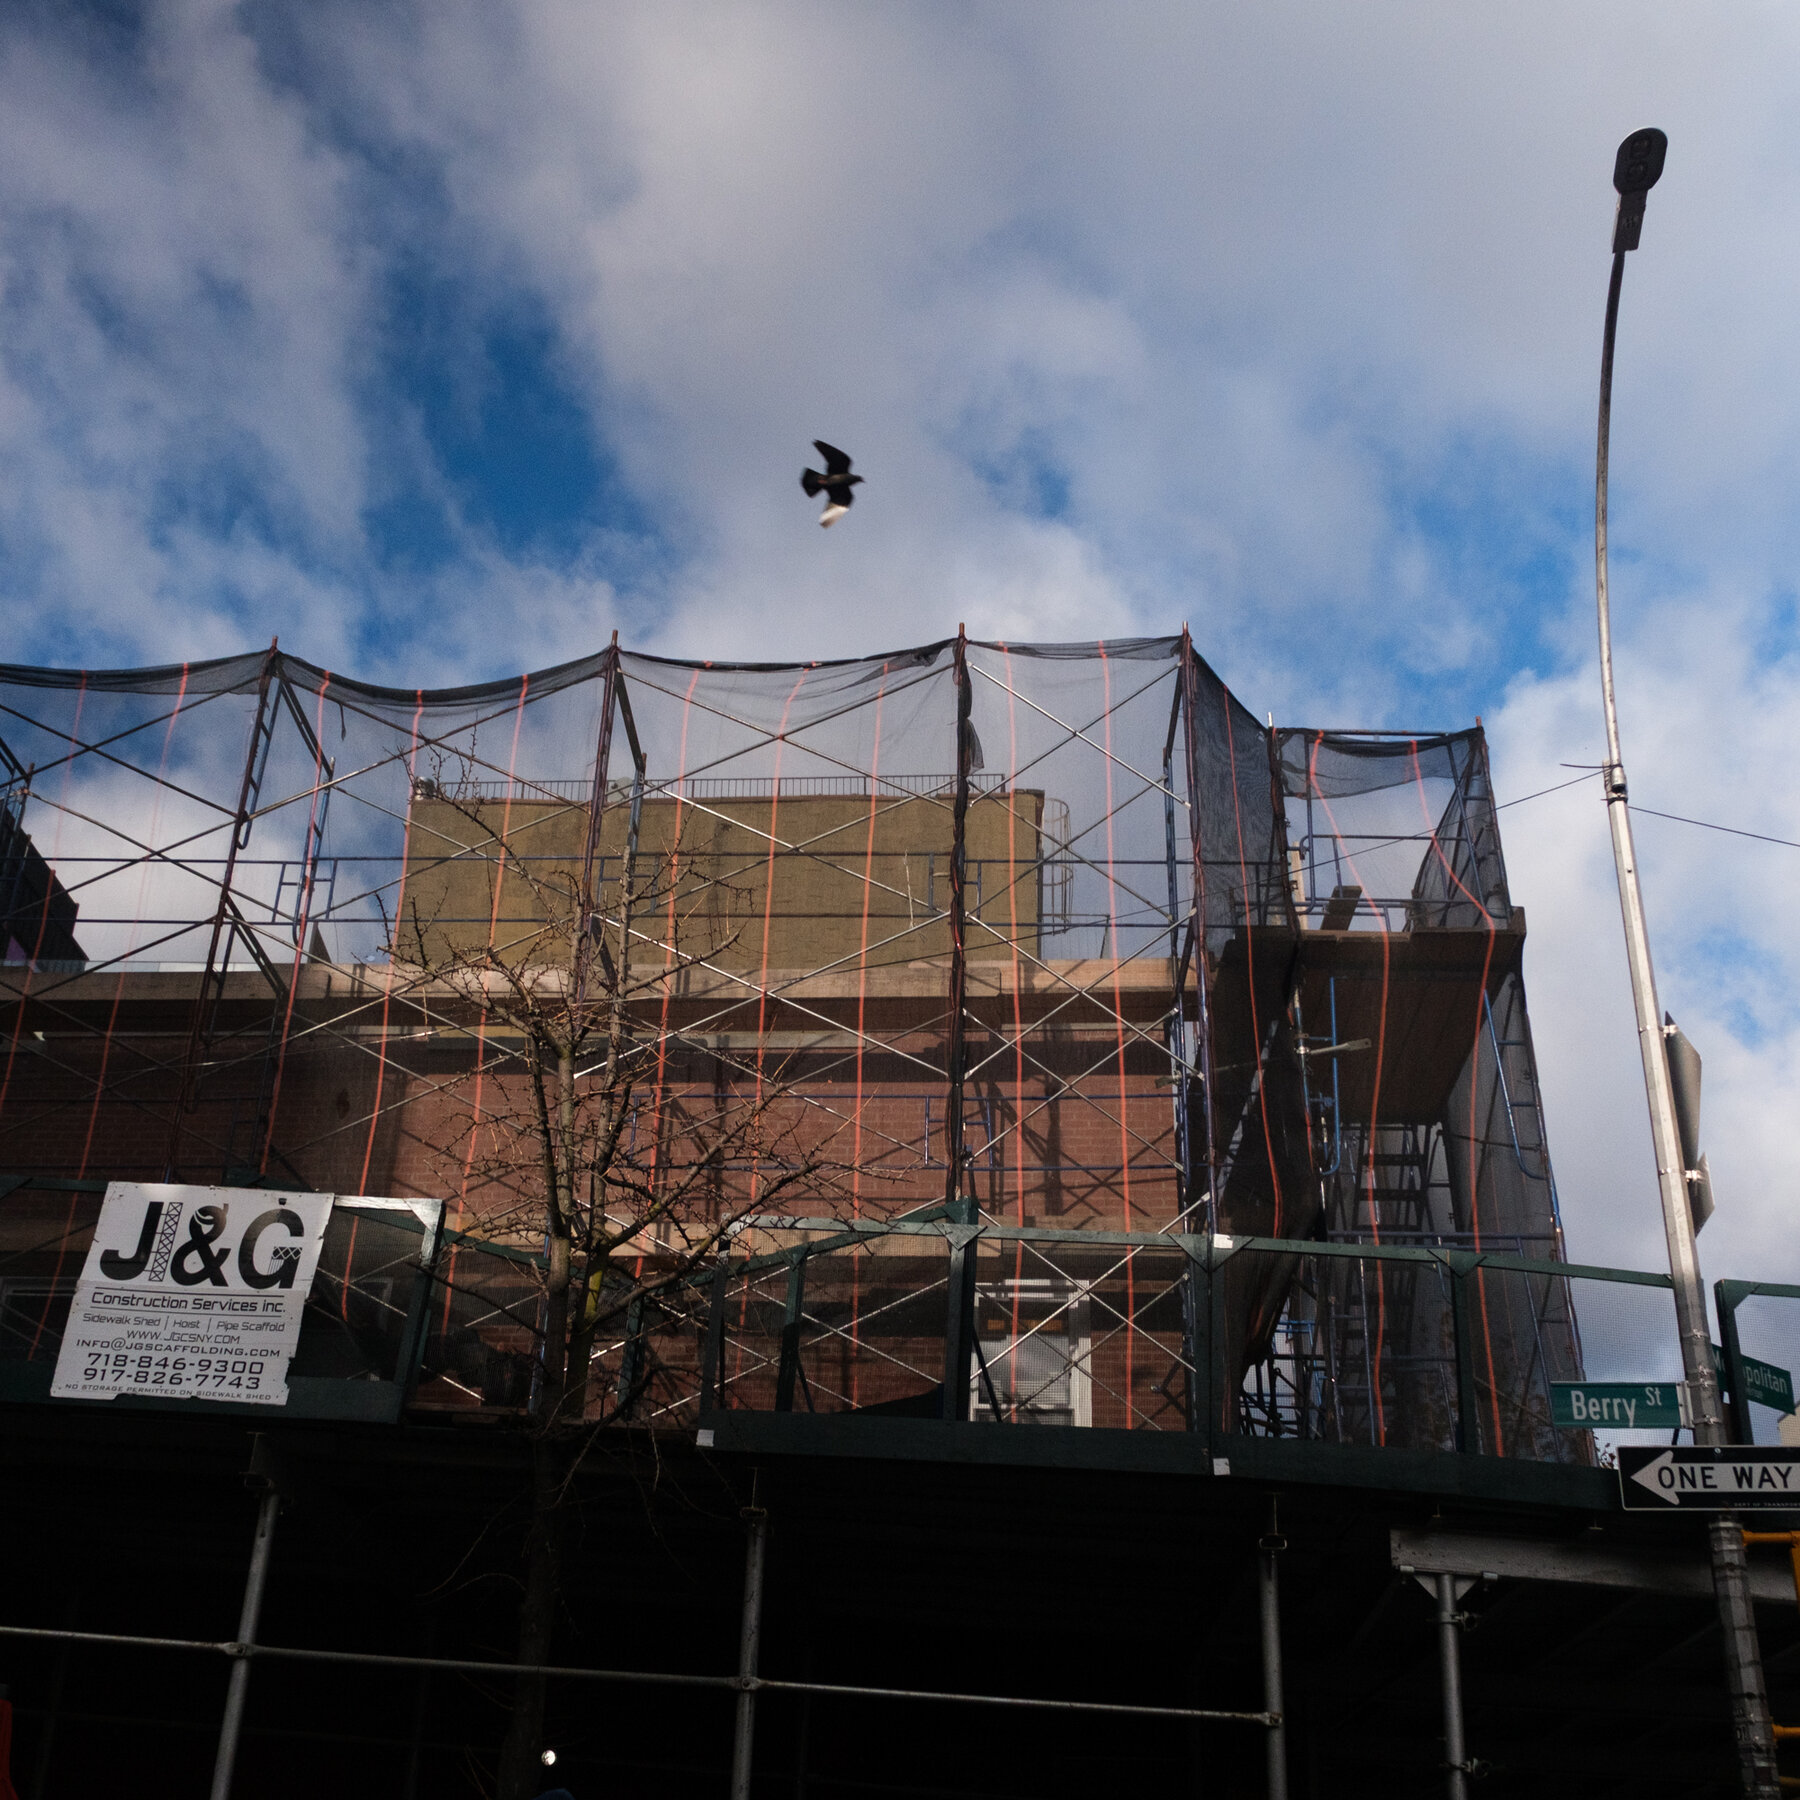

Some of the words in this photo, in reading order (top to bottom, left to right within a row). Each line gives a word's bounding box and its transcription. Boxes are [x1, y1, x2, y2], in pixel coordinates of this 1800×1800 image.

[100, 1199, 304, 1289] J&G
[92, 1292, 188, 1309] Construction
[192, 1298, 258, 1312] Services
[262, 1299, 286, 1312] inc.
[83, 1313, 131, 1325] Sidewalk
[133, 1316, 161, 1327] Shed
[173, 1319, 200, 1329] Hoist
[217, 1320, 239, 1332] Pipe
[241, 1321, 286, 1332] Scaffold
[76, 1337, 280, 1357] INFO@JGSCAFFOLDING.COM
[127, 1330, 240, 1344] WWW.JGCSNY.COM
[88, 1353, 264, 1374] 718-846-9300
[83, 1368, 260, 1389] 917-826-7743
[82, 1384, 123, 1392] STORAGE
[126, 1387, 177, 1395] PERMITTED
[196, 1391, 242, 1399] SIDEWALK
[1571, 1390, 1636, 1428] Berry
[1645, 1387, 1662, 1406] St
[1658, 1466, 1717, 1489] ONE
[1733, 1466, 1792, 1489] WAY
